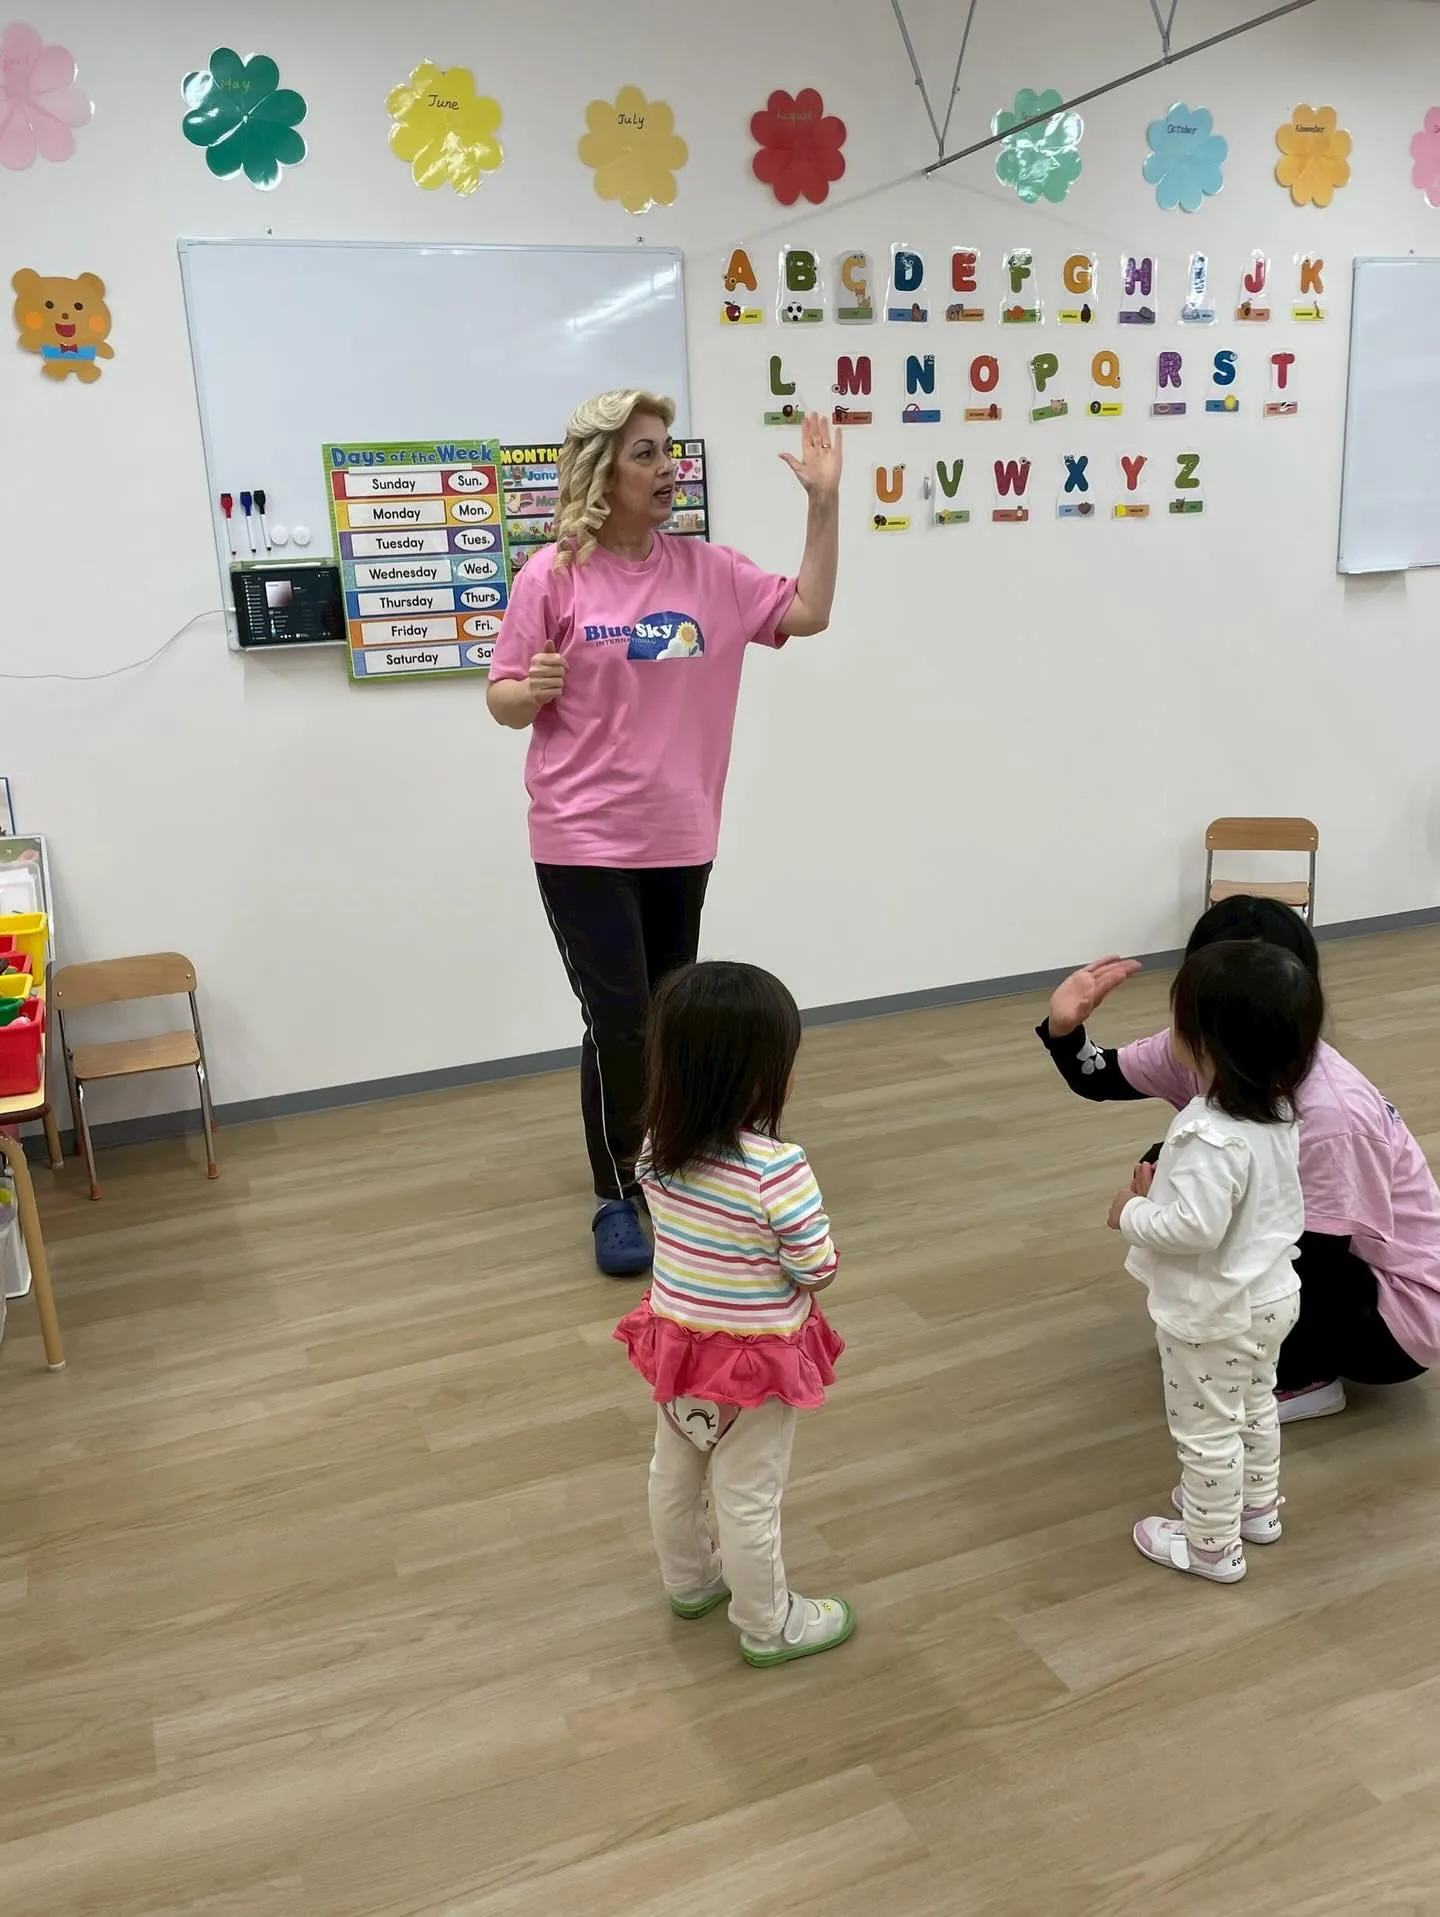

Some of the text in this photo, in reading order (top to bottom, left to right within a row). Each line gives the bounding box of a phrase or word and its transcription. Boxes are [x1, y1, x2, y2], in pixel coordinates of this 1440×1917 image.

[220, 76, 252, 94] May
[428, 93, 460, 112] June
[617, 113, 646, 130] July
[1167, 123, 1198, 136] October
[725, 249, 757, 291] A
[786, 250, 817, 291] B
[841, 253, 866, 292] C
[894, 251, 924, 291] D
[952, 253, 976, 291] E
[1008, 254, 1031, 293] F
[1064, 256, 1092, 293] G
[1125, 257, 1152, 296] H
[1244, 256, 1264, 293] J
[1301, 258, 1324, 294] K
[770, 350, 1295, 395] L M N O P Q R S T
[331, 443, 494, 467] Days of the Week
[458, 474, 483, 487] Sun.
[528, 471, 559, 482] Janu
[876, 453, 1200, 503] U V W X Y Z
[373, 478, 416, 492] Sunday
[374, 507, 421, 522] Monday
[459, 505, 488, 516] Mon.
[376, 537, 424, 551] Tuesday
[461, 534, 491, 545] Tues.
[369, 566, 437, 580] Wednesday
[464, 563, 493, 574] Wed.
[380, 595, 433, 609] Thursday
[464, 591, 499, 604] Thurs.
[391, 624, 428, 638] Friday
[475, 619, 493, 631] Fri.
[584, 623, 673, 641] Blue Sky
[386, 652, 439, 666] Saturday
